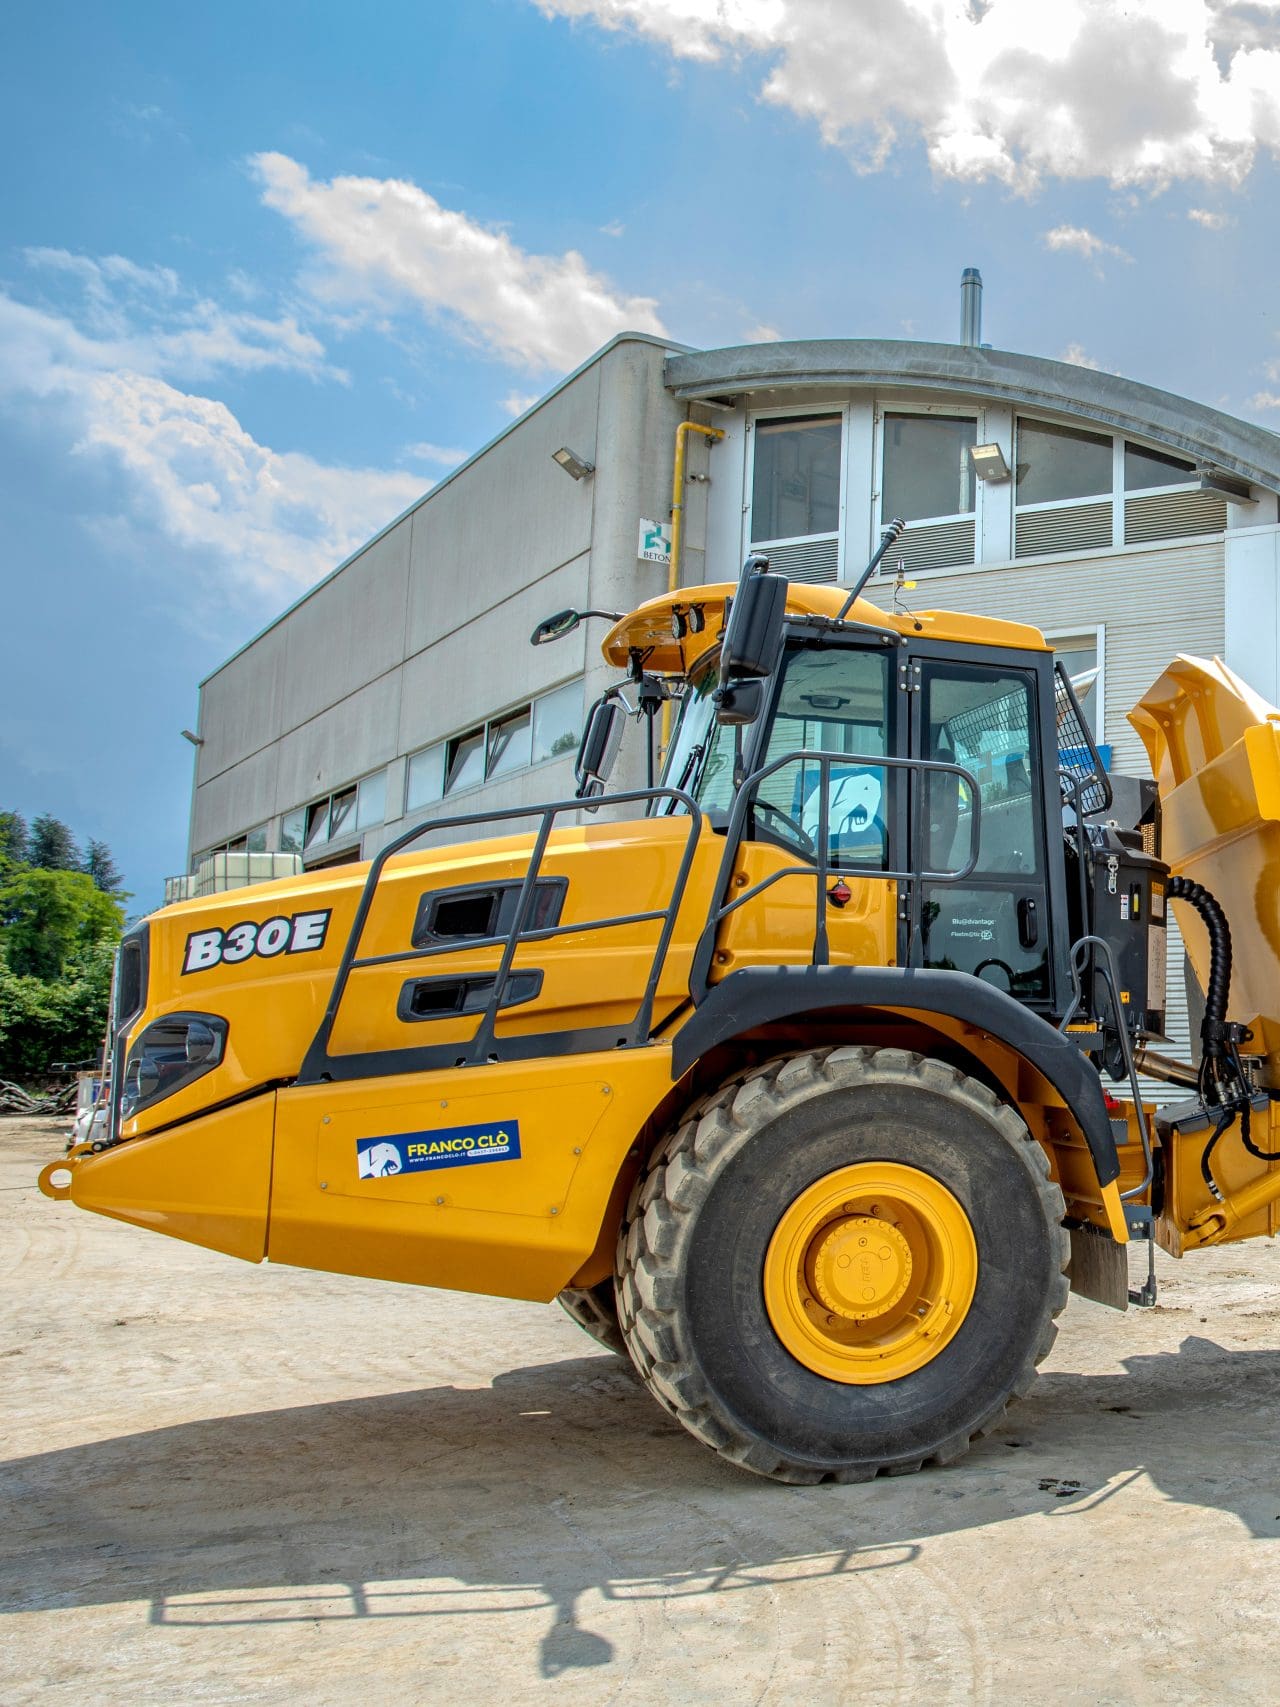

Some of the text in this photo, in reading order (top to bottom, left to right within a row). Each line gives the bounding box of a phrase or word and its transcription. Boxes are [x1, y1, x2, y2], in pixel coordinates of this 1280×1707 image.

[183, 910, 331, 974] B30E
[407, 1137, 475, 1157] FRANCO
[477, 1130, 509, 1148] CLÒ
